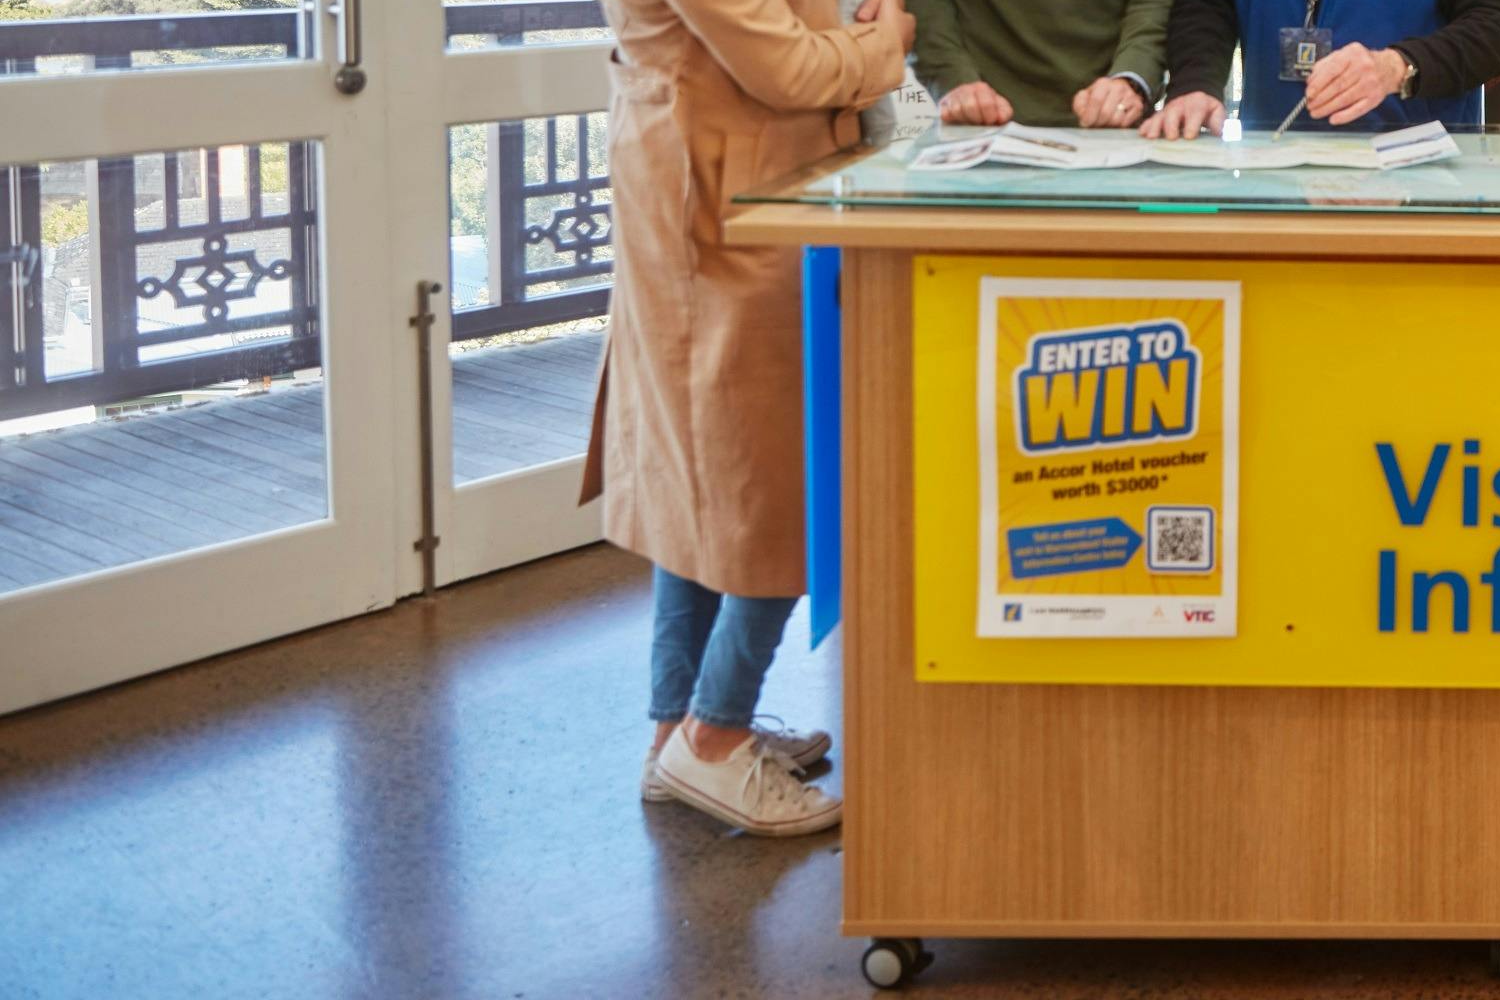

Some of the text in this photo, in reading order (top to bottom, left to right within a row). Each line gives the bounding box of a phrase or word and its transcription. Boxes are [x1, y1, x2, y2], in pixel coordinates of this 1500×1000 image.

[1039, 331, 1177, 373] ENTER TO
[1025, 358, 1189, 445] WIN
[1012, 451, 1208, 484] an Accor Hotel voucher
[1052, 480, 1100, 501] worth
